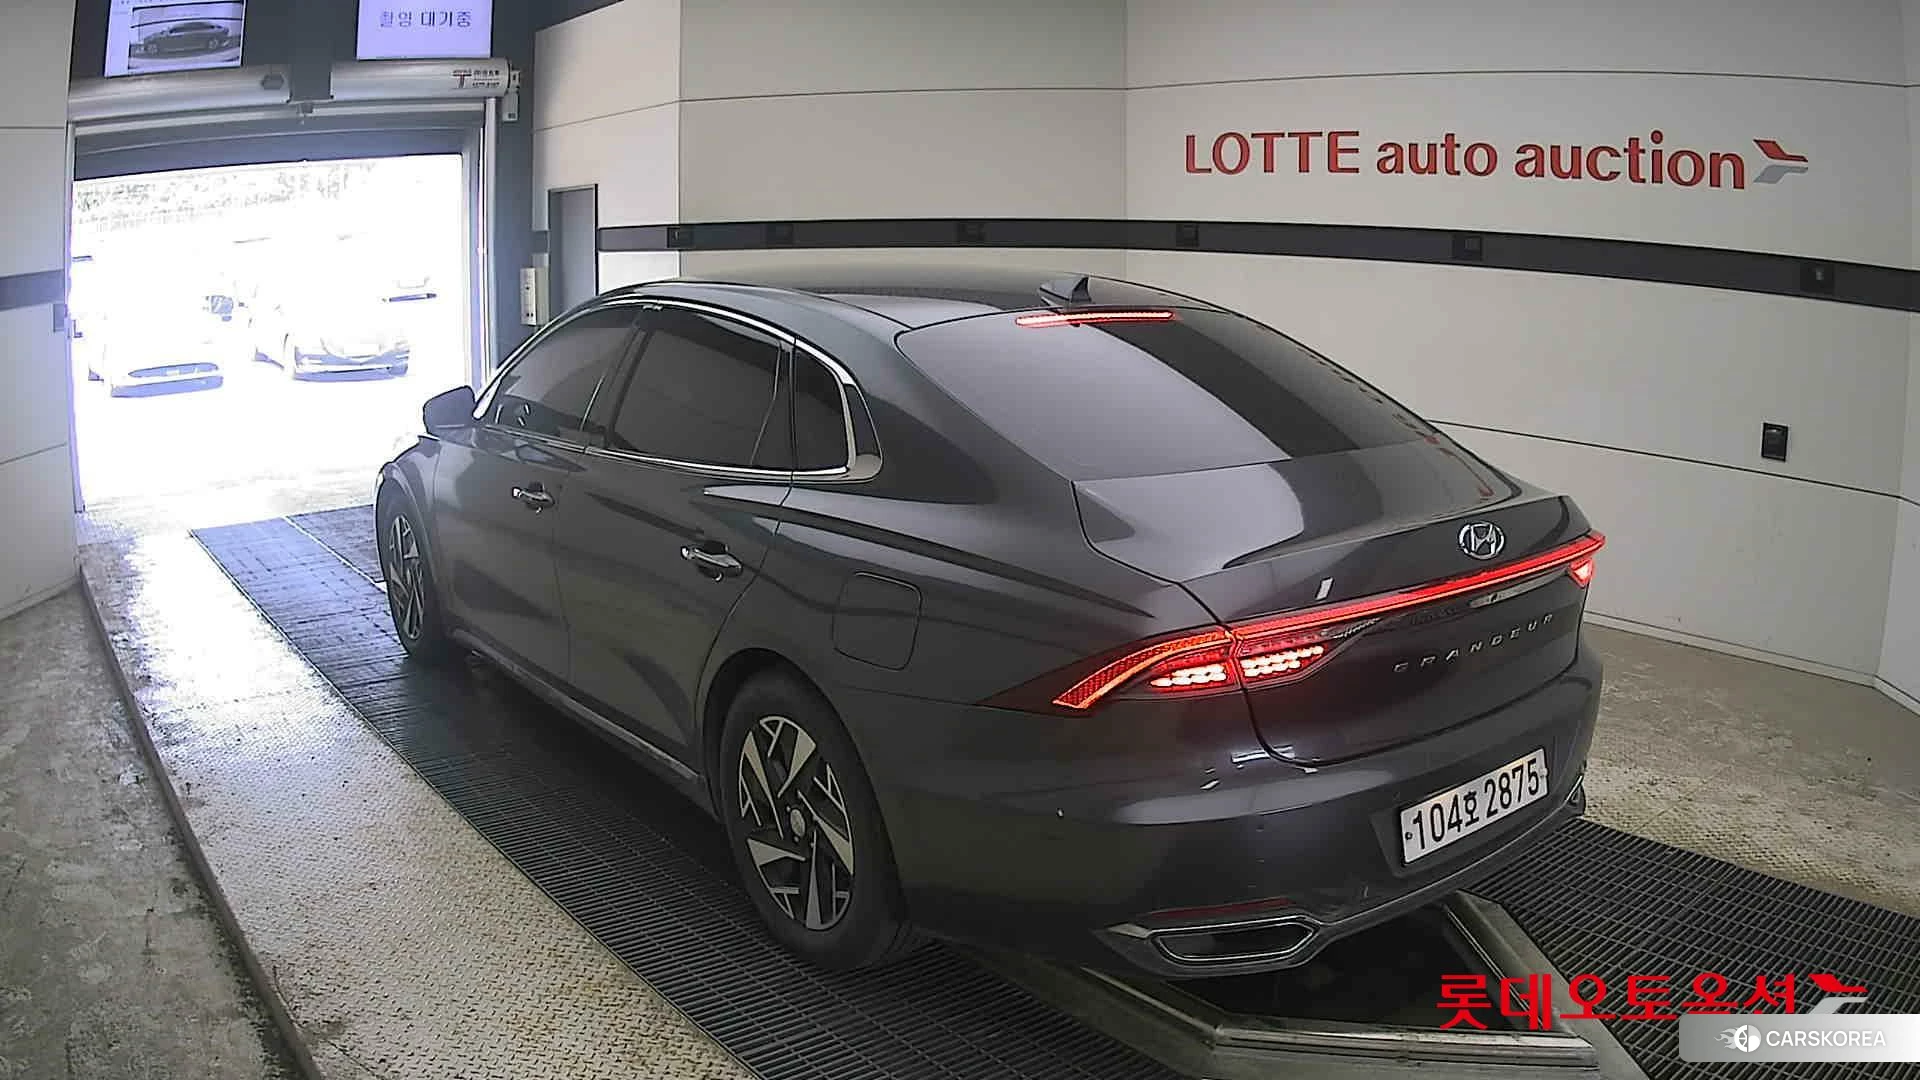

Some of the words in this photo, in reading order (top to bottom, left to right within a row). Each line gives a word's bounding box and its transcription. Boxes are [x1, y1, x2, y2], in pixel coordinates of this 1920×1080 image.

[1185, 130, 1360, 175] LOTTE
[1376, 132, 1499, 177] auto
[1514, 130, 1746, 190] auction
[1393, 613, 1553, 673] GRANDEUR
[1483, 758, 1540, 819] 2875
